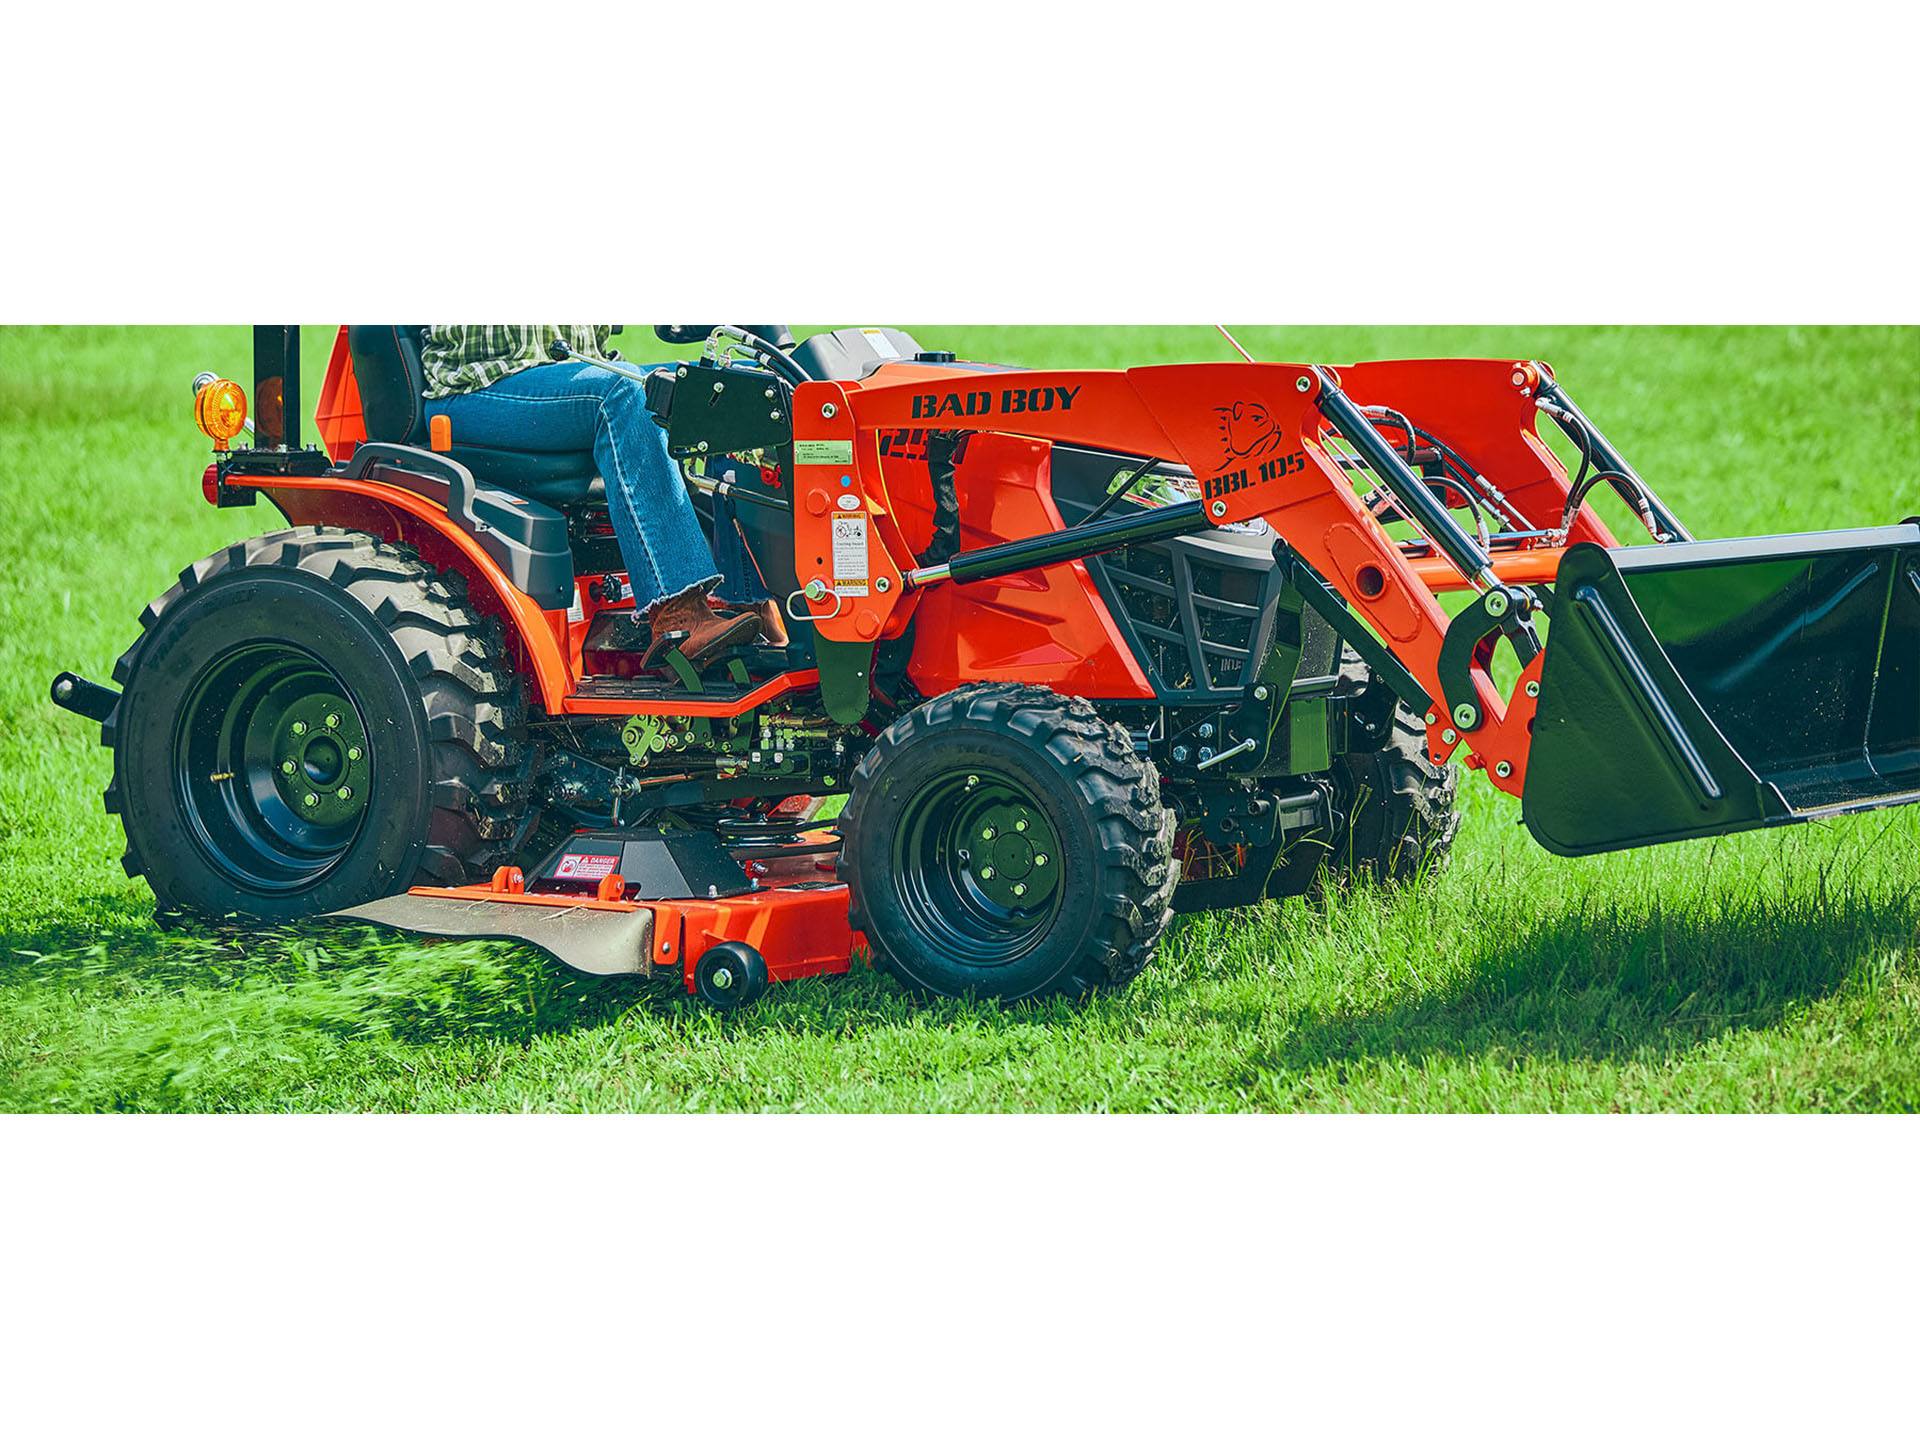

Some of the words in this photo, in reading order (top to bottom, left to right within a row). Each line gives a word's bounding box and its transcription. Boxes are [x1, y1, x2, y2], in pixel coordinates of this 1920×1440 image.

[912, 392, 991, 419] BAD
[1001, 385, 1082, 413] BOY
[1204, 469, 1256, 500] BBL
[1258, 451, 1305, 483] 105
[590, 857, 615, 865] DANGER
